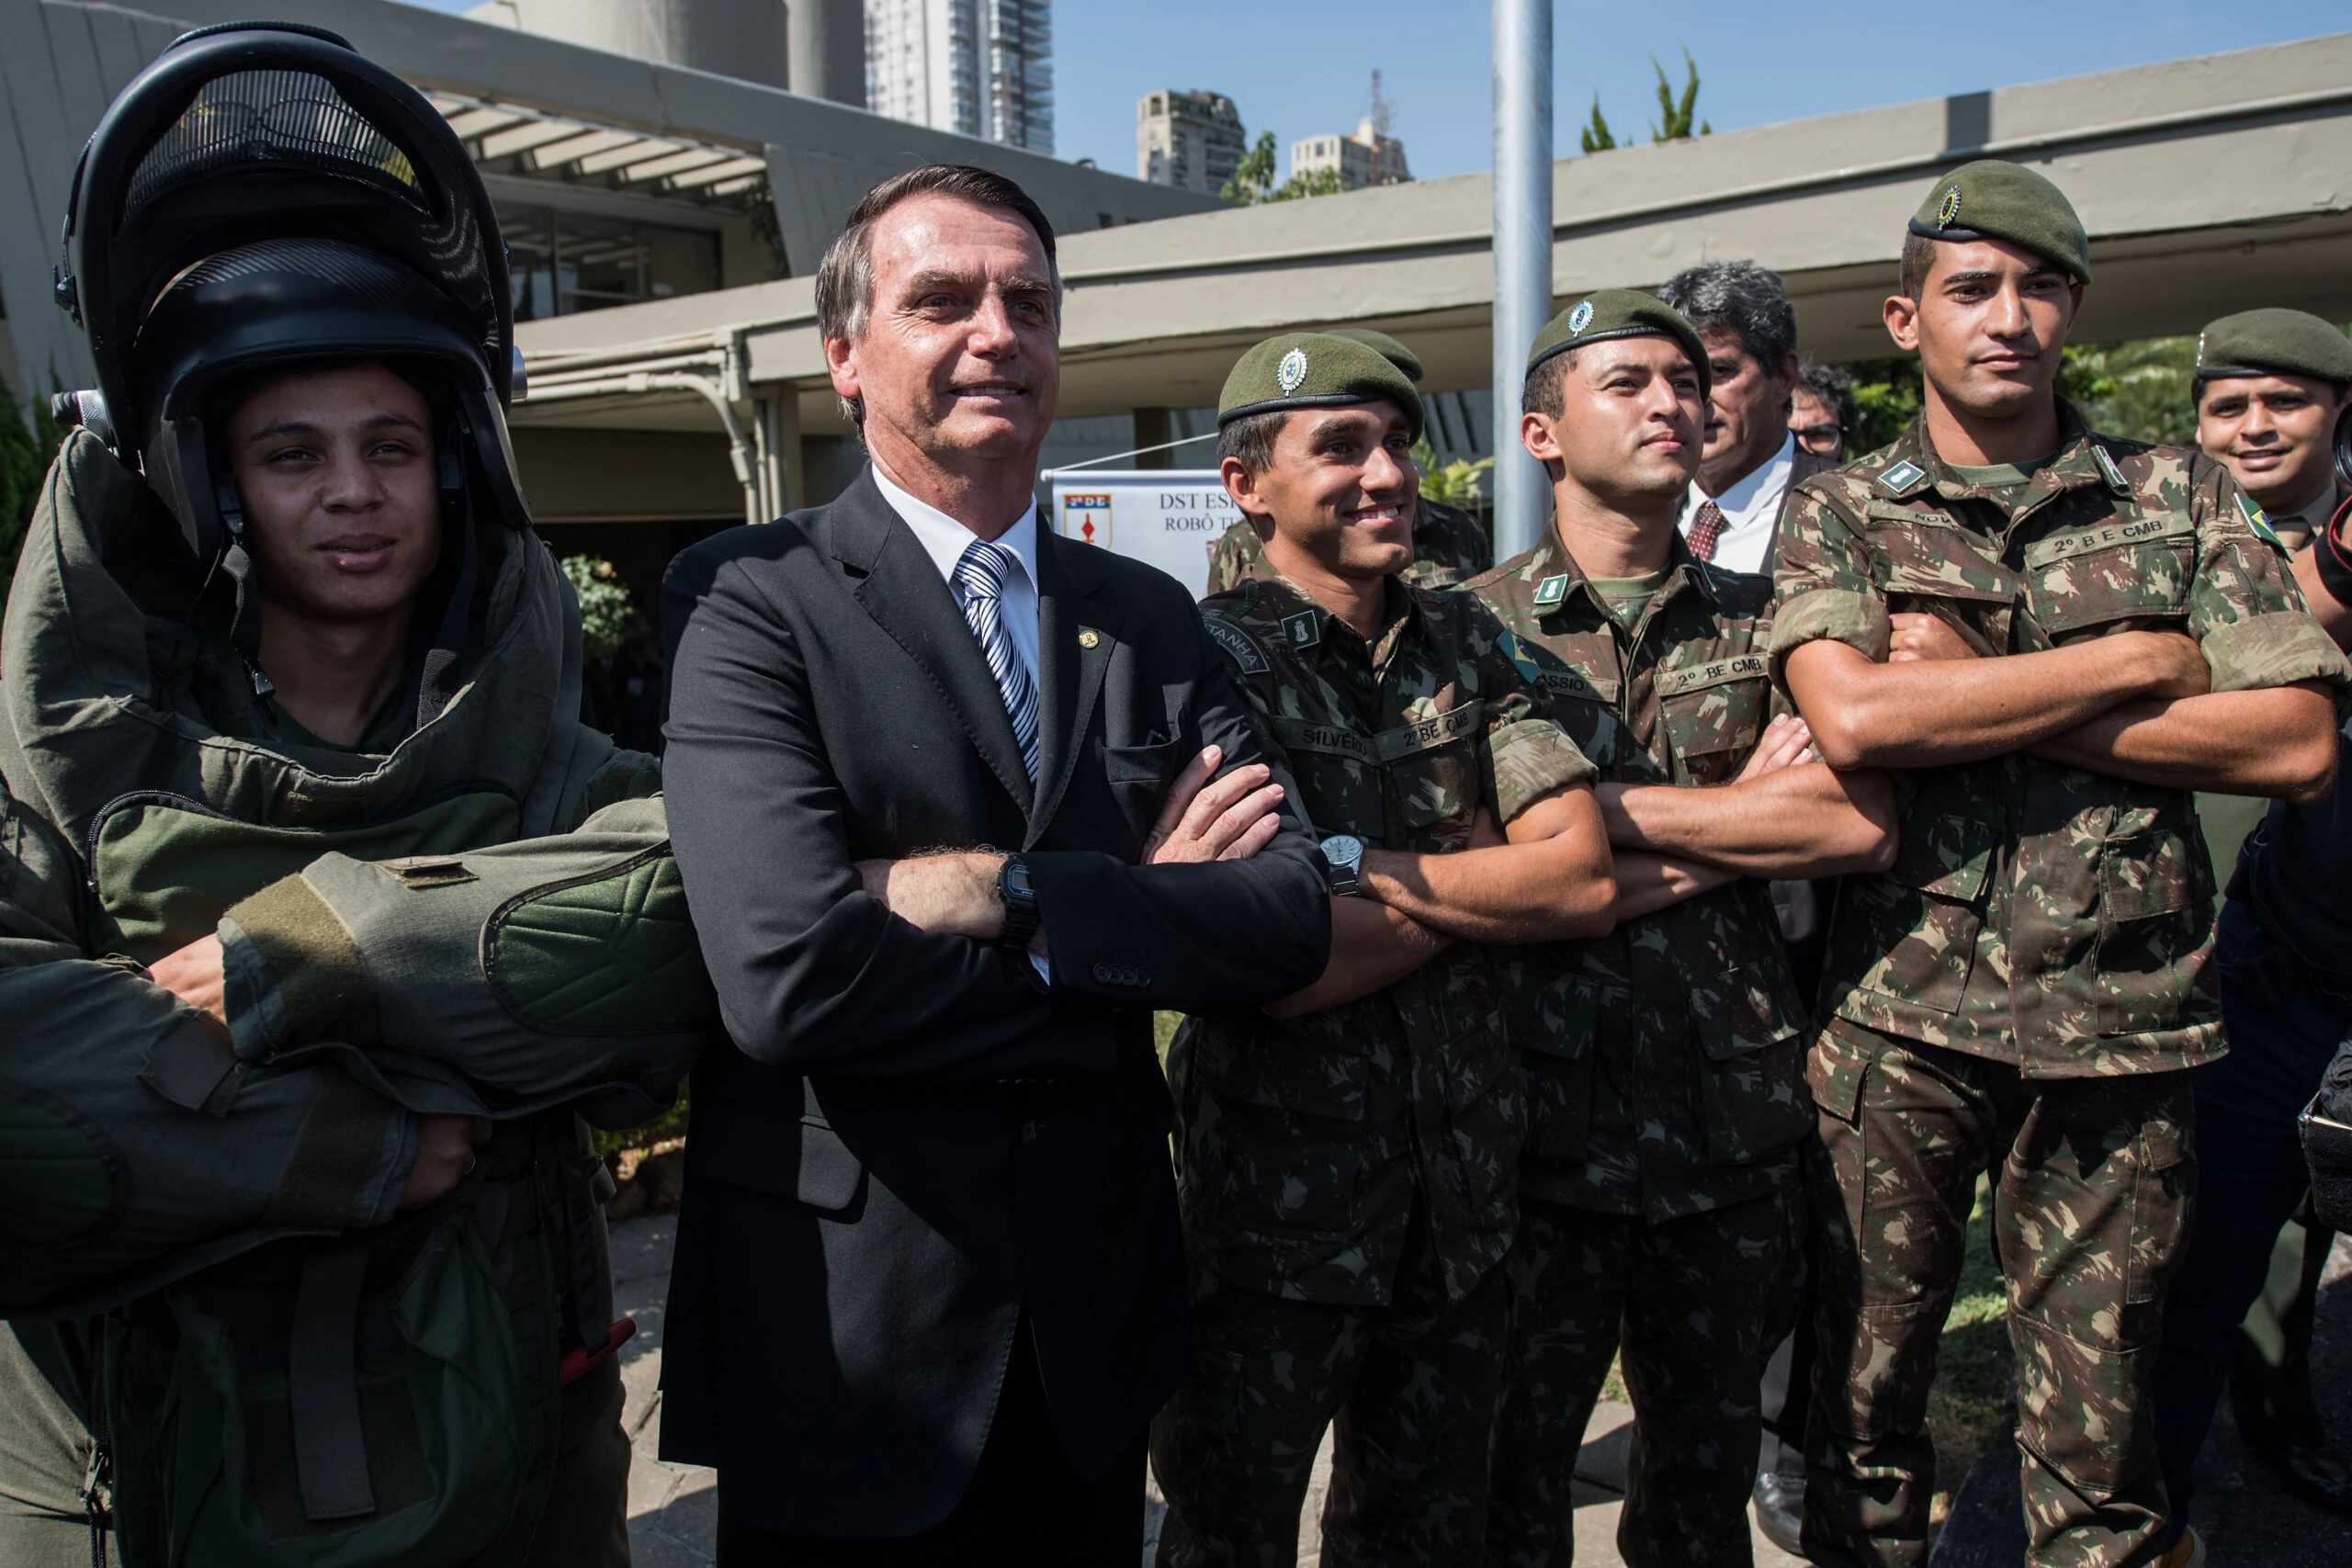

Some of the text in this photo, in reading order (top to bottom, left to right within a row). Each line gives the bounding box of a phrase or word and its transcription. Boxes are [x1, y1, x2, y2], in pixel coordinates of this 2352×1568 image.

[1160, 493, 1199, 510] DST
[1165, 513, 1214, 531] ROBÔ
[1916, 513, 1950, 524] NOV
[2122, 521, 2163, 537] CMB
[1204, 624, 1258, 666] TANHA
[1541, 673, 1584, 691] ASSIO
[1679, 659, 1762, 687] 2º BE CMB
[1419, 723, 1441, 742] BE
[1446, 712, 1469, 733] CMB
